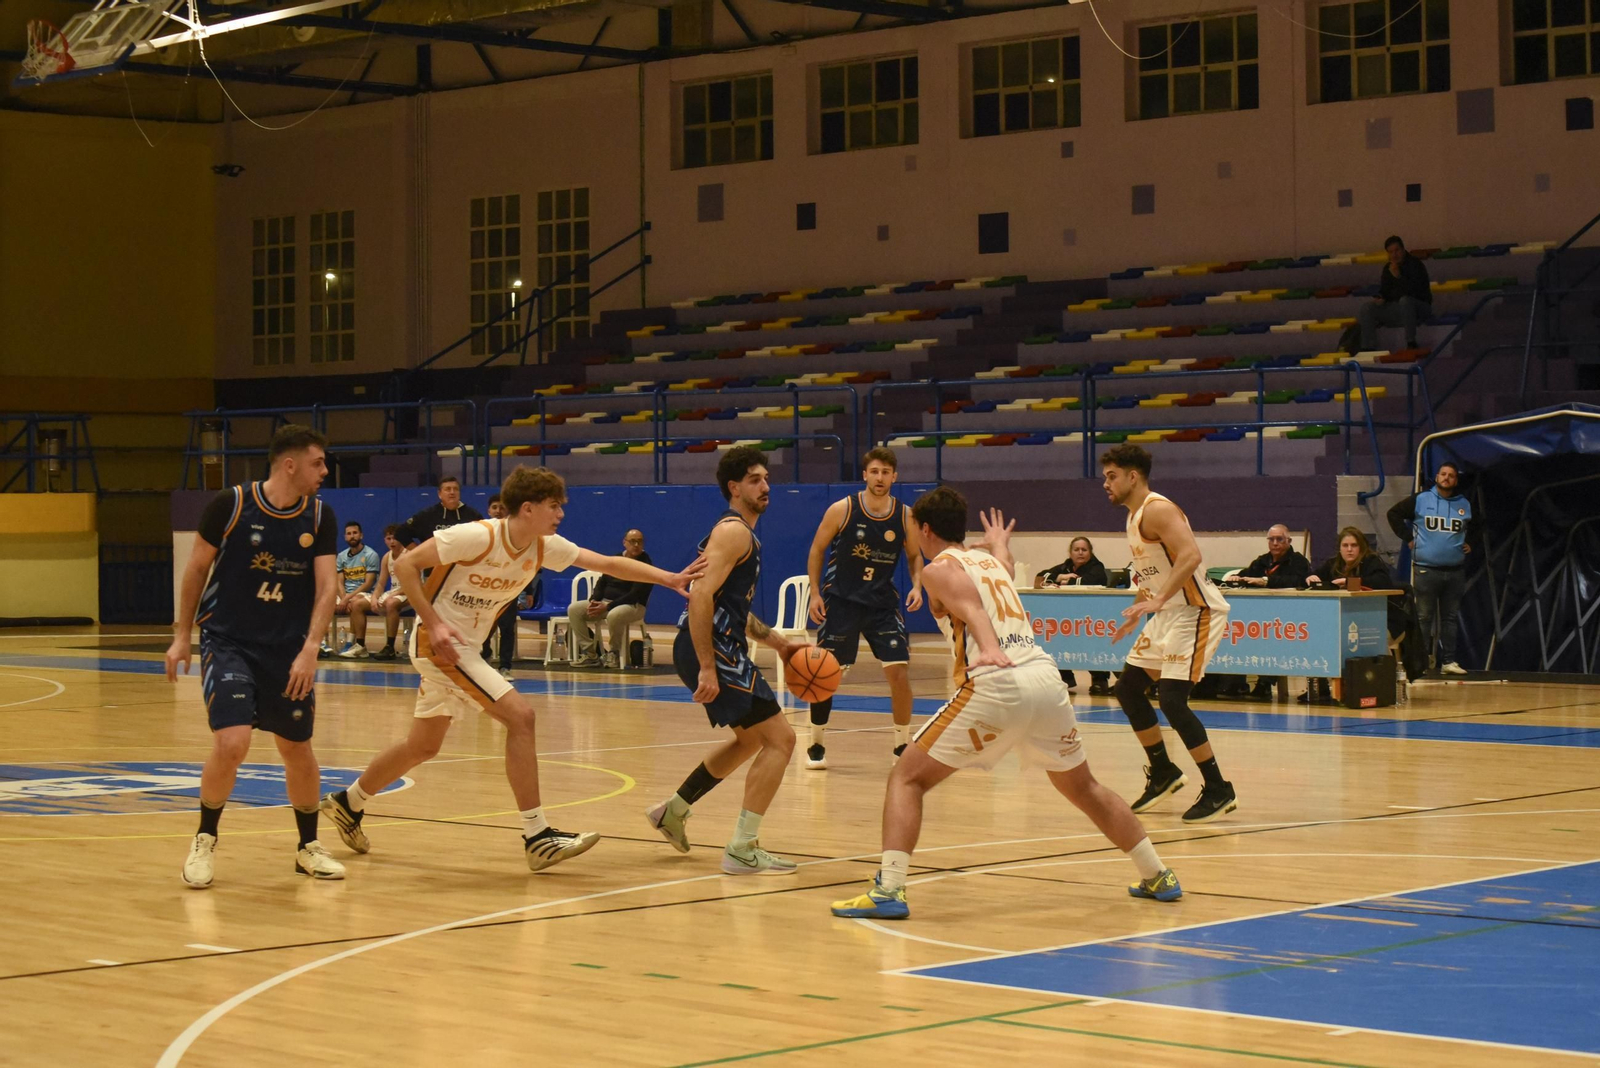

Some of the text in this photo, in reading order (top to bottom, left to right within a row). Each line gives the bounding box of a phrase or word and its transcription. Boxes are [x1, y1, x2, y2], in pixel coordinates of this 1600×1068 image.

[1425, 516, 1463, 533] ULB
[468, 573, 517, 590] CBCM
[863, 567, 874, 581] 3
[256, 581, 283, 602] 44
[981, 576, 1024, 622] 10
[1025, 611, 1117, 642] eportes
[1221, 617, 1309, 645] eportes
